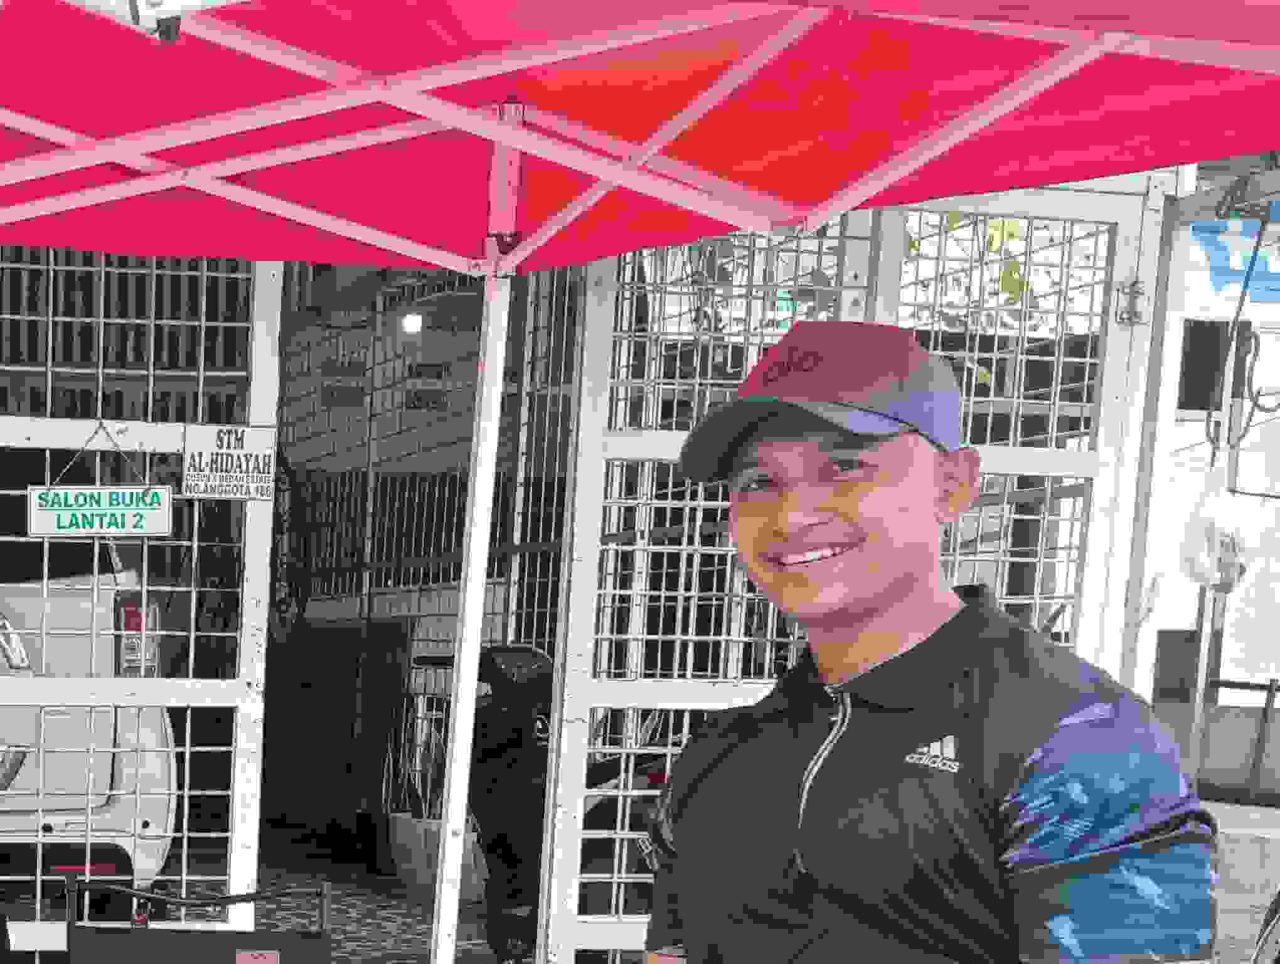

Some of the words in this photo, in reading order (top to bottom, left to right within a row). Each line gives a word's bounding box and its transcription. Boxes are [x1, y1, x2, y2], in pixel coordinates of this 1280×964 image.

[216, 428, 245, 450] STM
[187, 452, 272, 474] AL-HIDAYAH
[38, 491, 101, 508] SALON
[109, 491, 161, 508] BUKA
[56, 512, 125, 529] LANTAI
[132, 512, 145, 529] 2
